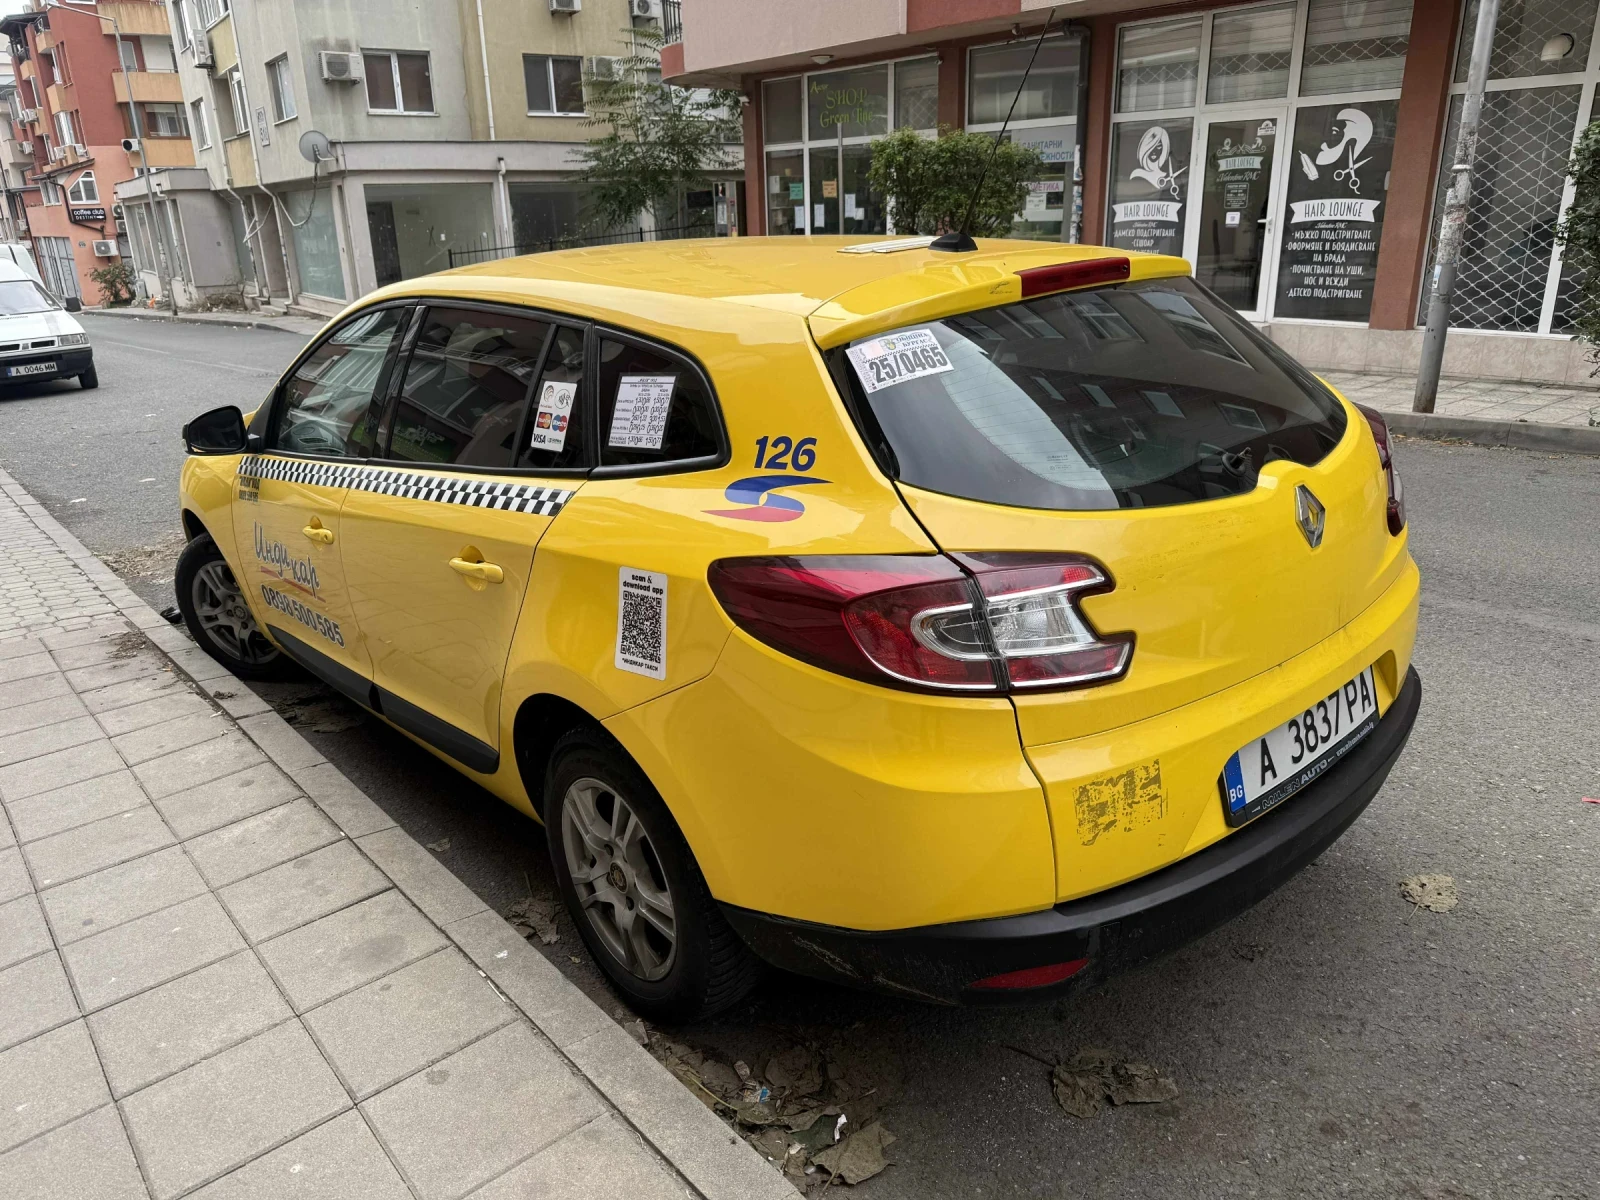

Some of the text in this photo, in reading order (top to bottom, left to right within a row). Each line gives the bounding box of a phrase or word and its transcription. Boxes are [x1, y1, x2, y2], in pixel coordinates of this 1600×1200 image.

[826, 87, 868, 109] SHOP
[820, 108, 873, 128] Green Line
[1124, 204, 1170, 218] HAIR LOUNGE
[1304, 202, 1364, 218] HAIR LOUNGE
[1136, 228, 1176, 237] ПОДСТРИГВАНЕ
[1321, 230, 1372, 240] ПОДСТРИГВАНЕ
[1324, 242, 1330, 251] И
[1332, 242, 1376, 252] БОЯДИСВАНЕ
[1313, 254, 1346, 263] НА БРАДА
[1334, 266, 1344, 274] НА
[1346, 266, 1364, 276] УШИ,
[1304, 277, 1349, 287] НОС И ВЕЖДИ
[1314, 289, 1363, 299] ПОДСТРИГВАНЕ
[24, 366, 44, 374] 0046
[868, 347, 948, 383] 25/0465
[534, 434, 546, 444] VISA
[754, 436, 817, 472] 126
[632, 574, 652, 584] scan &
[623, 580, 664, 595] download app
[261, 584, 345, 648] 0898 500 585
[1260, 737, 1278, 787] A
[1288, 689, 1340, 765] 3837
[1344, 672, 1372, 723] PA
[1301, 759, 1328, 785] AUTO
[1230, 784, 1243, 802] BG
